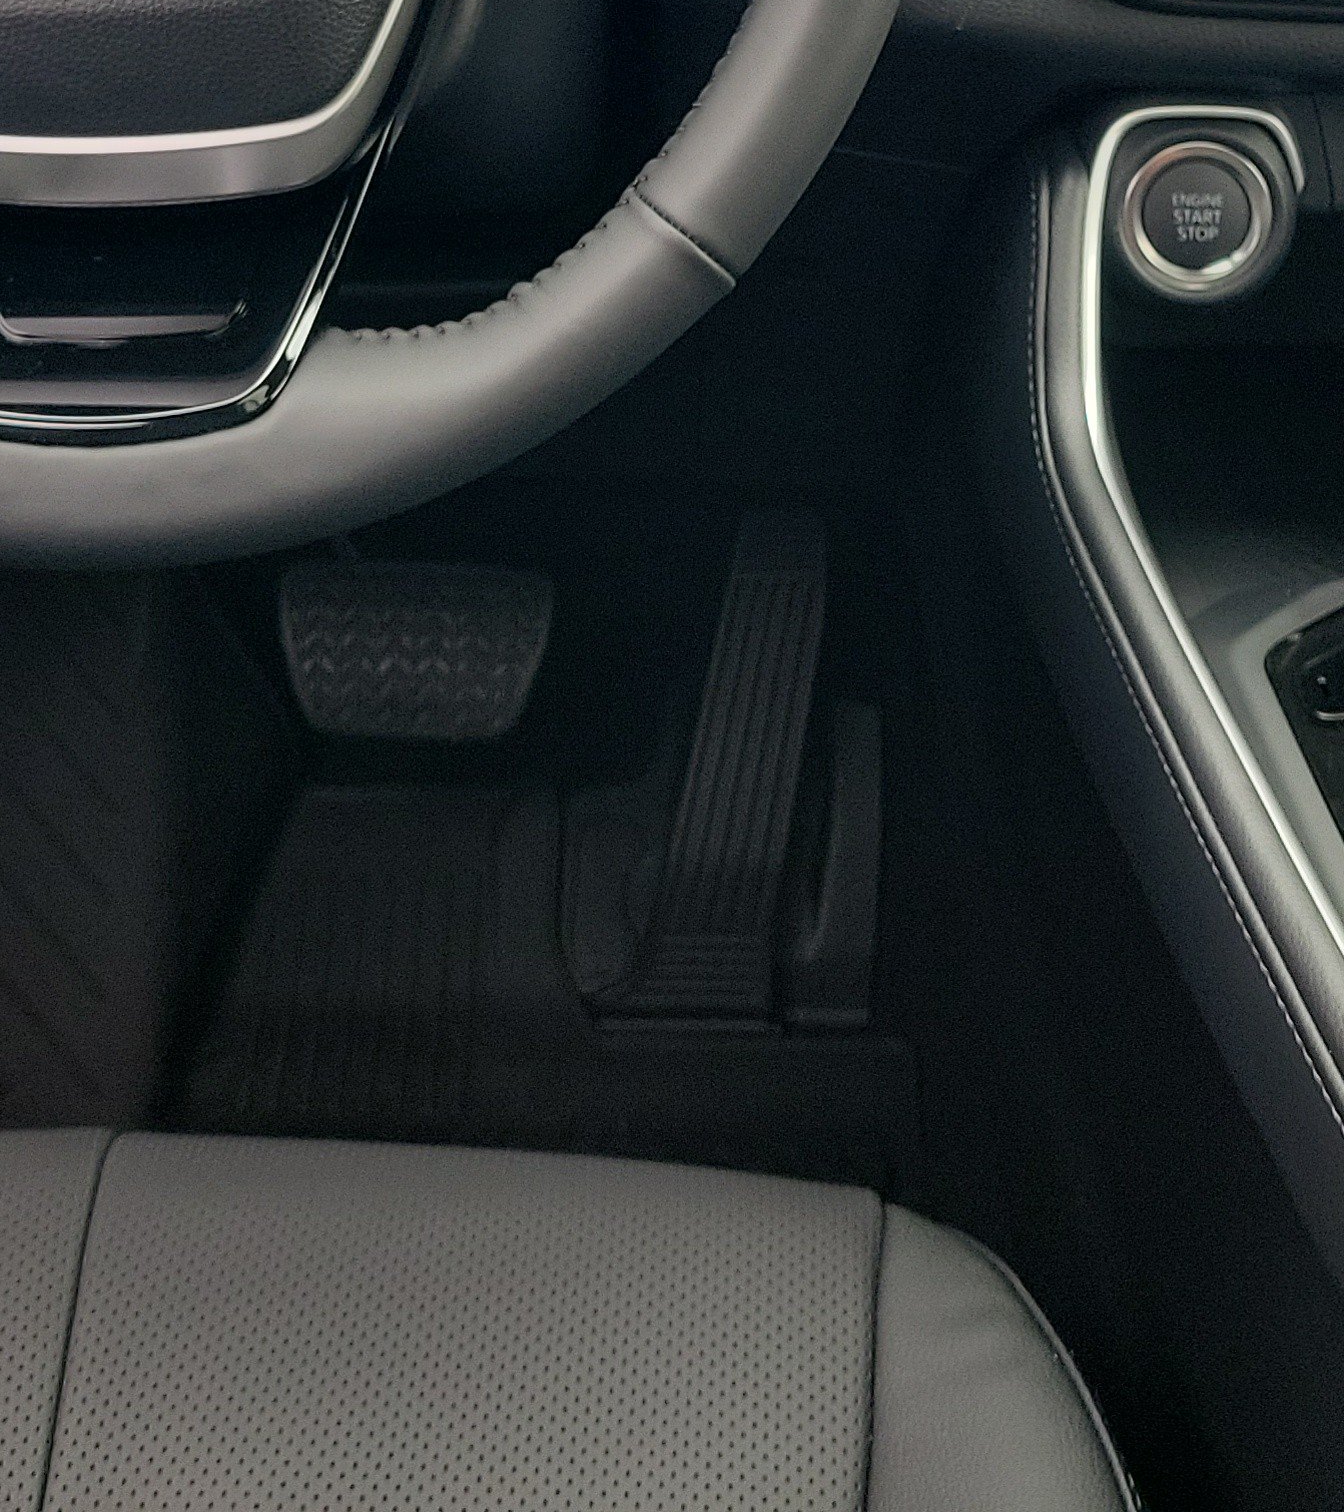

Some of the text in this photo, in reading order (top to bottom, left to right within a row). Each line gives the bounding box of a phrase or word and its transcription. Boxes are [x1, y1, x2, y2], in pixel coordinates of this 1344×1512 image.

[1171, 192, 1224, 208] ENGINE
[1172, 209, 1223, 224] START
[1177, 226, 1220, 242] STOP
